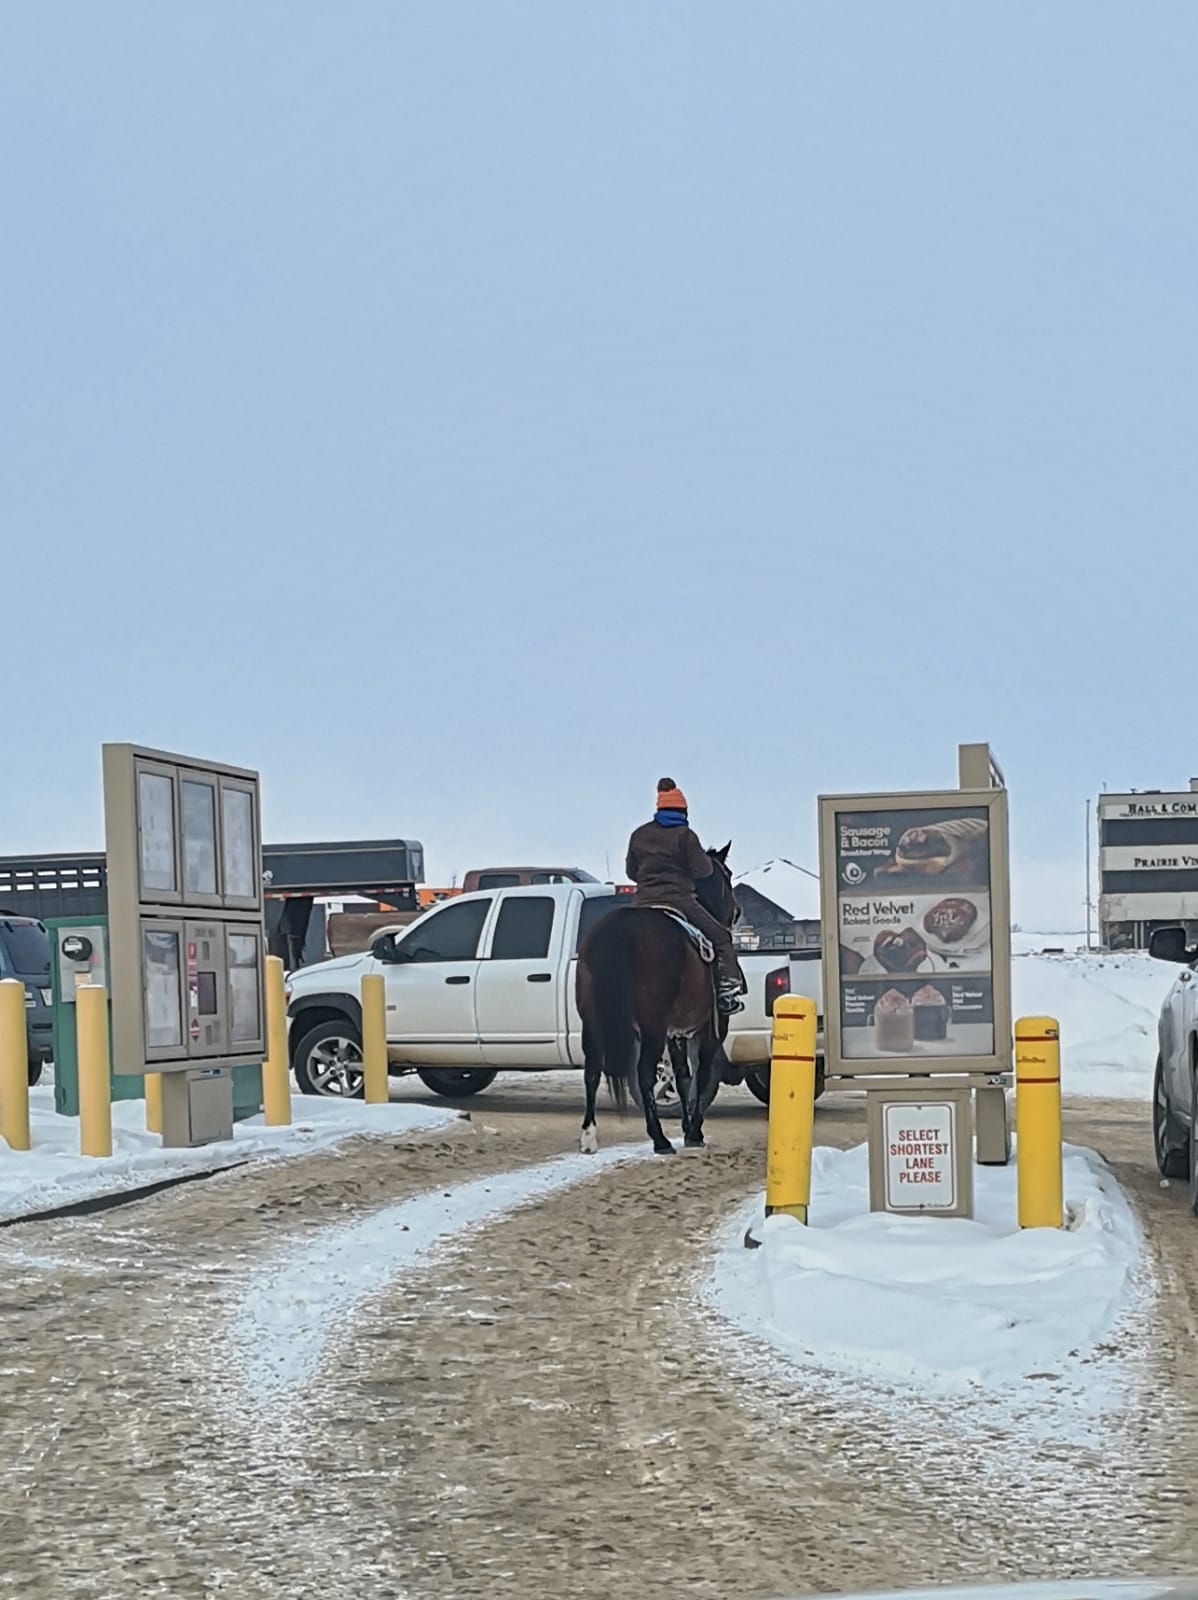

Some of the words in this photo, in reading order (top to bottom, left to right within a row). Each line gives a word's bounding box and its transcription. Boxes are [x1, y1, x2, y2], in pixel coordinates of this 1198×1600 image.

[1128, 803, 1157, 814] HALL
[1161, 803, 1168, 812] &
[840, 825, 891, 838] Sausage
[841, 837, 849, 847] &
[851, 836, 889, 847] Bacon
[1134, 857, 1178, 867] PRAIRIE
[843, 902, 870, 916] Red
[873, 901, 914, 915] Velvet
[898, 1129, 940, 1141] SELECT
[890, 1143, 949, 1155] SHORTEST
[905, 1157, 935, 1169] LANE
[899, 1171, 942, 1183] PLEASE
